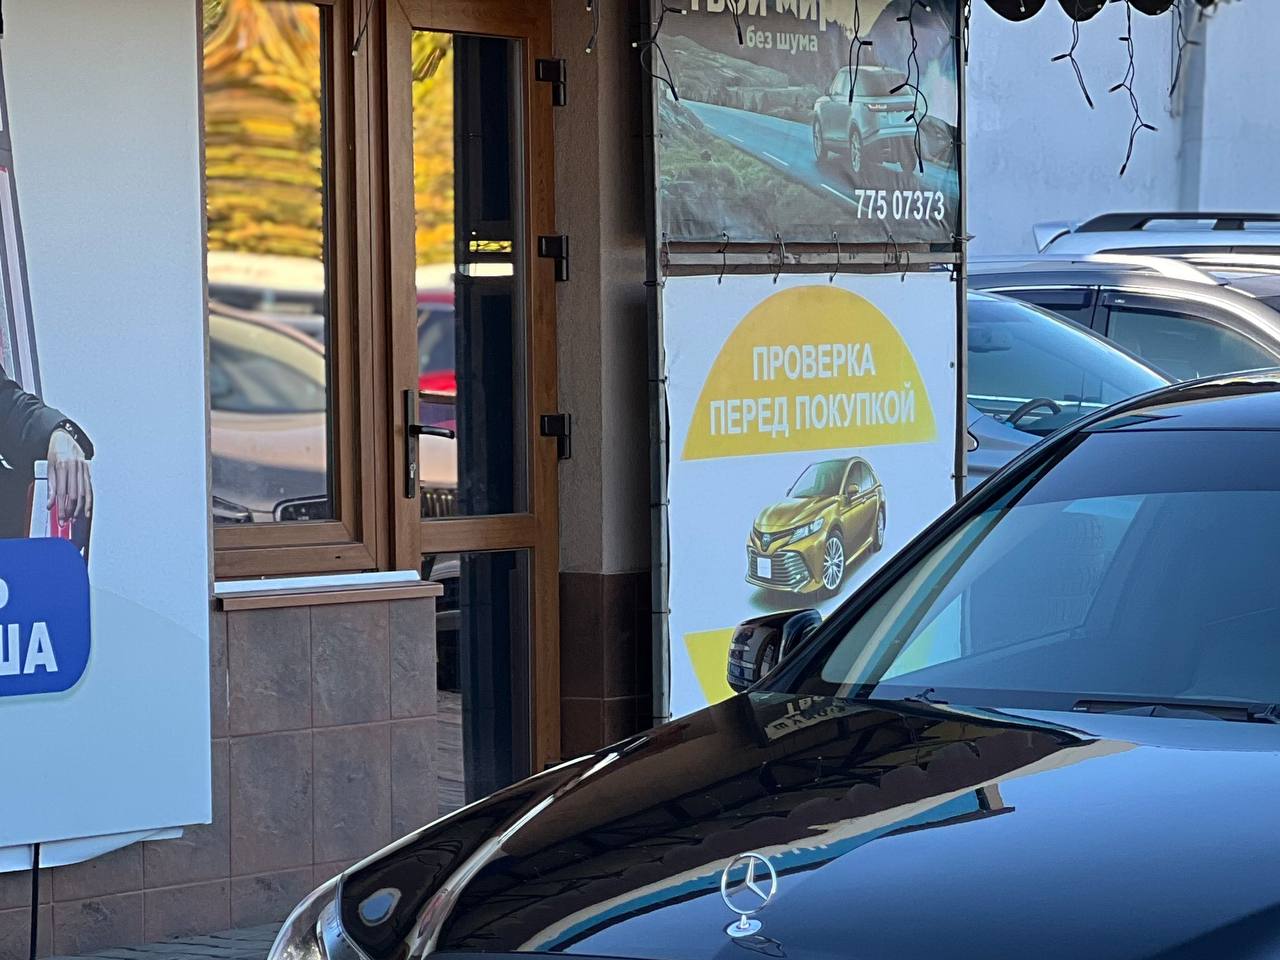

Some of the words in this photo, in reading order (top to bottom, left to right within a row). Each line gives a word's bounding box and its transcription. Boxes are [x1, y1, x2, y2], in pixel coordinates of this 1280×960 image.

[746, 25, 773, 49] без
[776, 32, 818, 55] шума
[854, 189, 887, 220] 775
[892, 190, 945, 220] 07373
[752, 342, 876, 381] ПРОВЕРКА
[710, 396, 790, 438] ПЕРЕД
[795, 381, 915, 431] ПОКУПКОЙ
